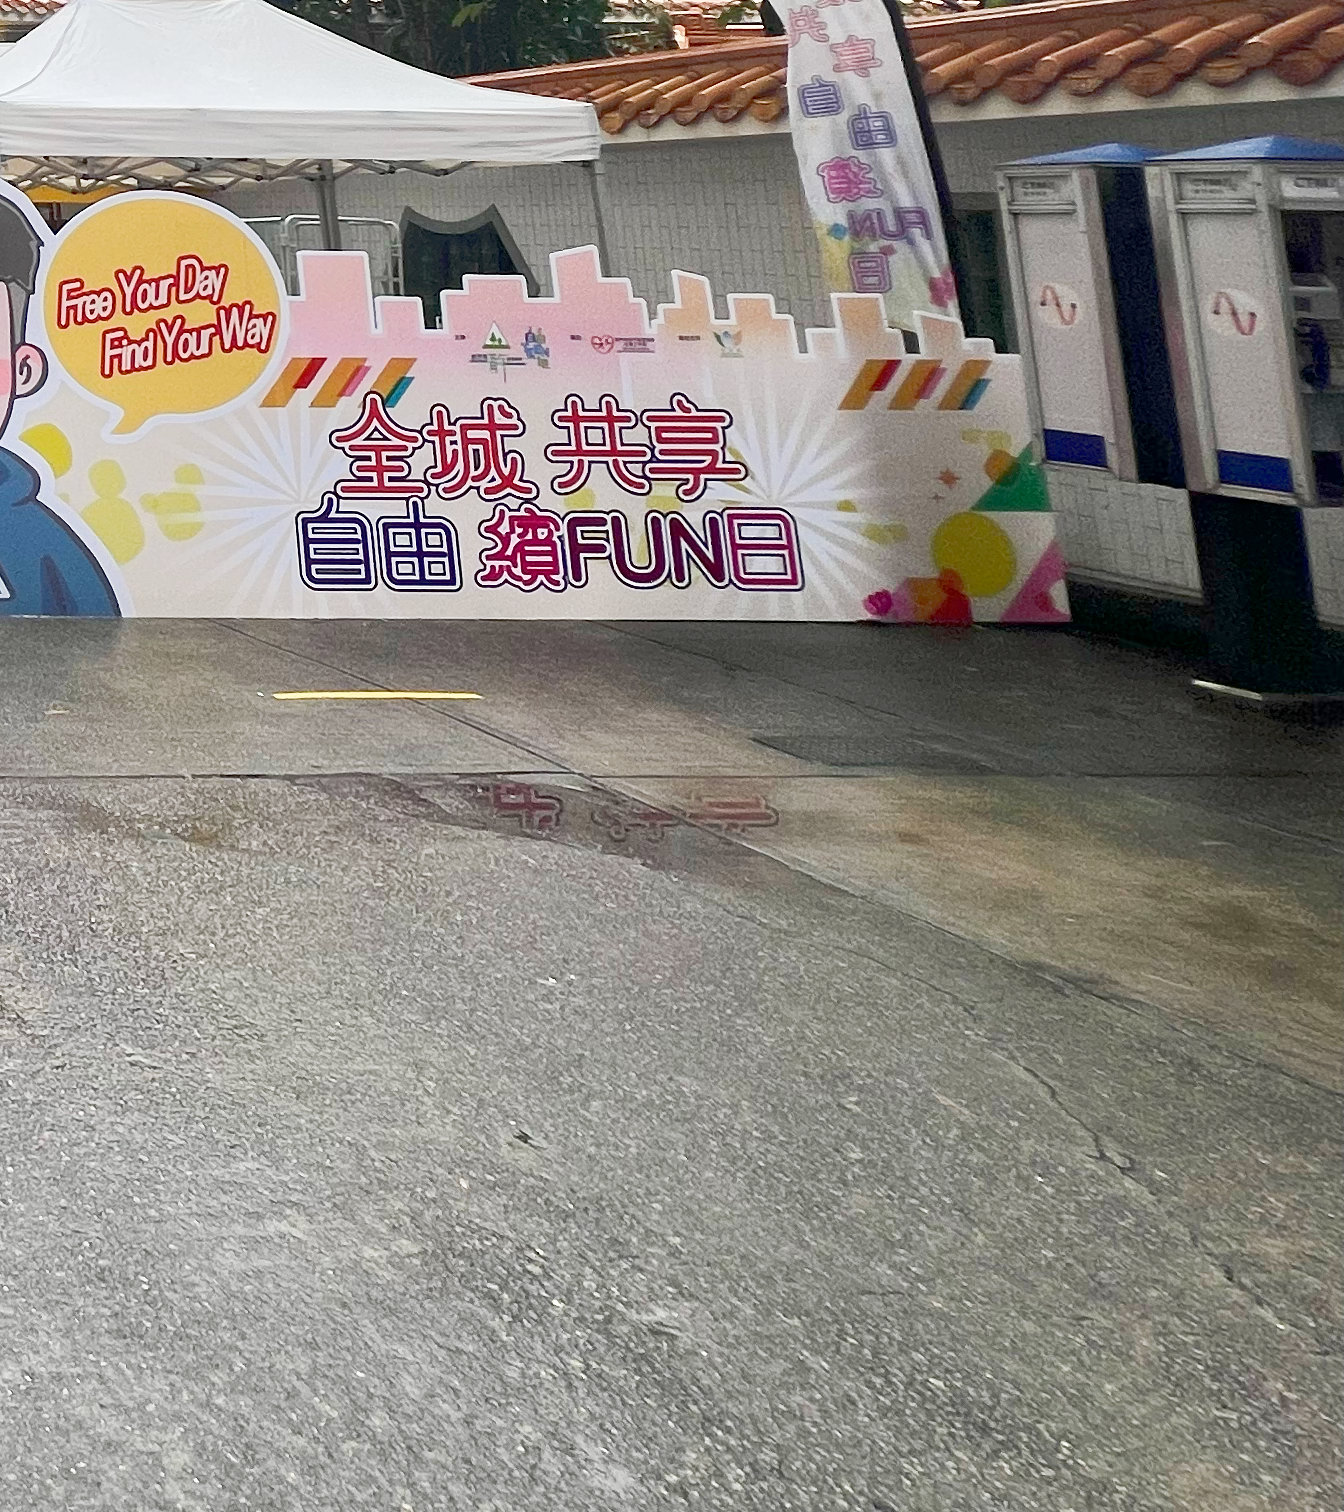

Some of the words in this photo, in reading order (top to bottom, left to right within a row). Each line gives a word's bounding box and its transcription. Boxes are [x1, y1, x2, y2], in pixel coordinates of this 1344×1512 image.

[58, 279, 115, 329] Free
[115, 265, 175, 315] Your
[176, 255, 228, 305] Day
[101, 327, 155, 378] Find
[157, 315, 216, 365] Your
[217, 301, 276, 353] Way
[330, 392, 538, 500] 全城
[545, 393, 748, 501] 共享
[296, 492, 462, 591] 自由
[475, 503, 805, 593] 繽FUN日
